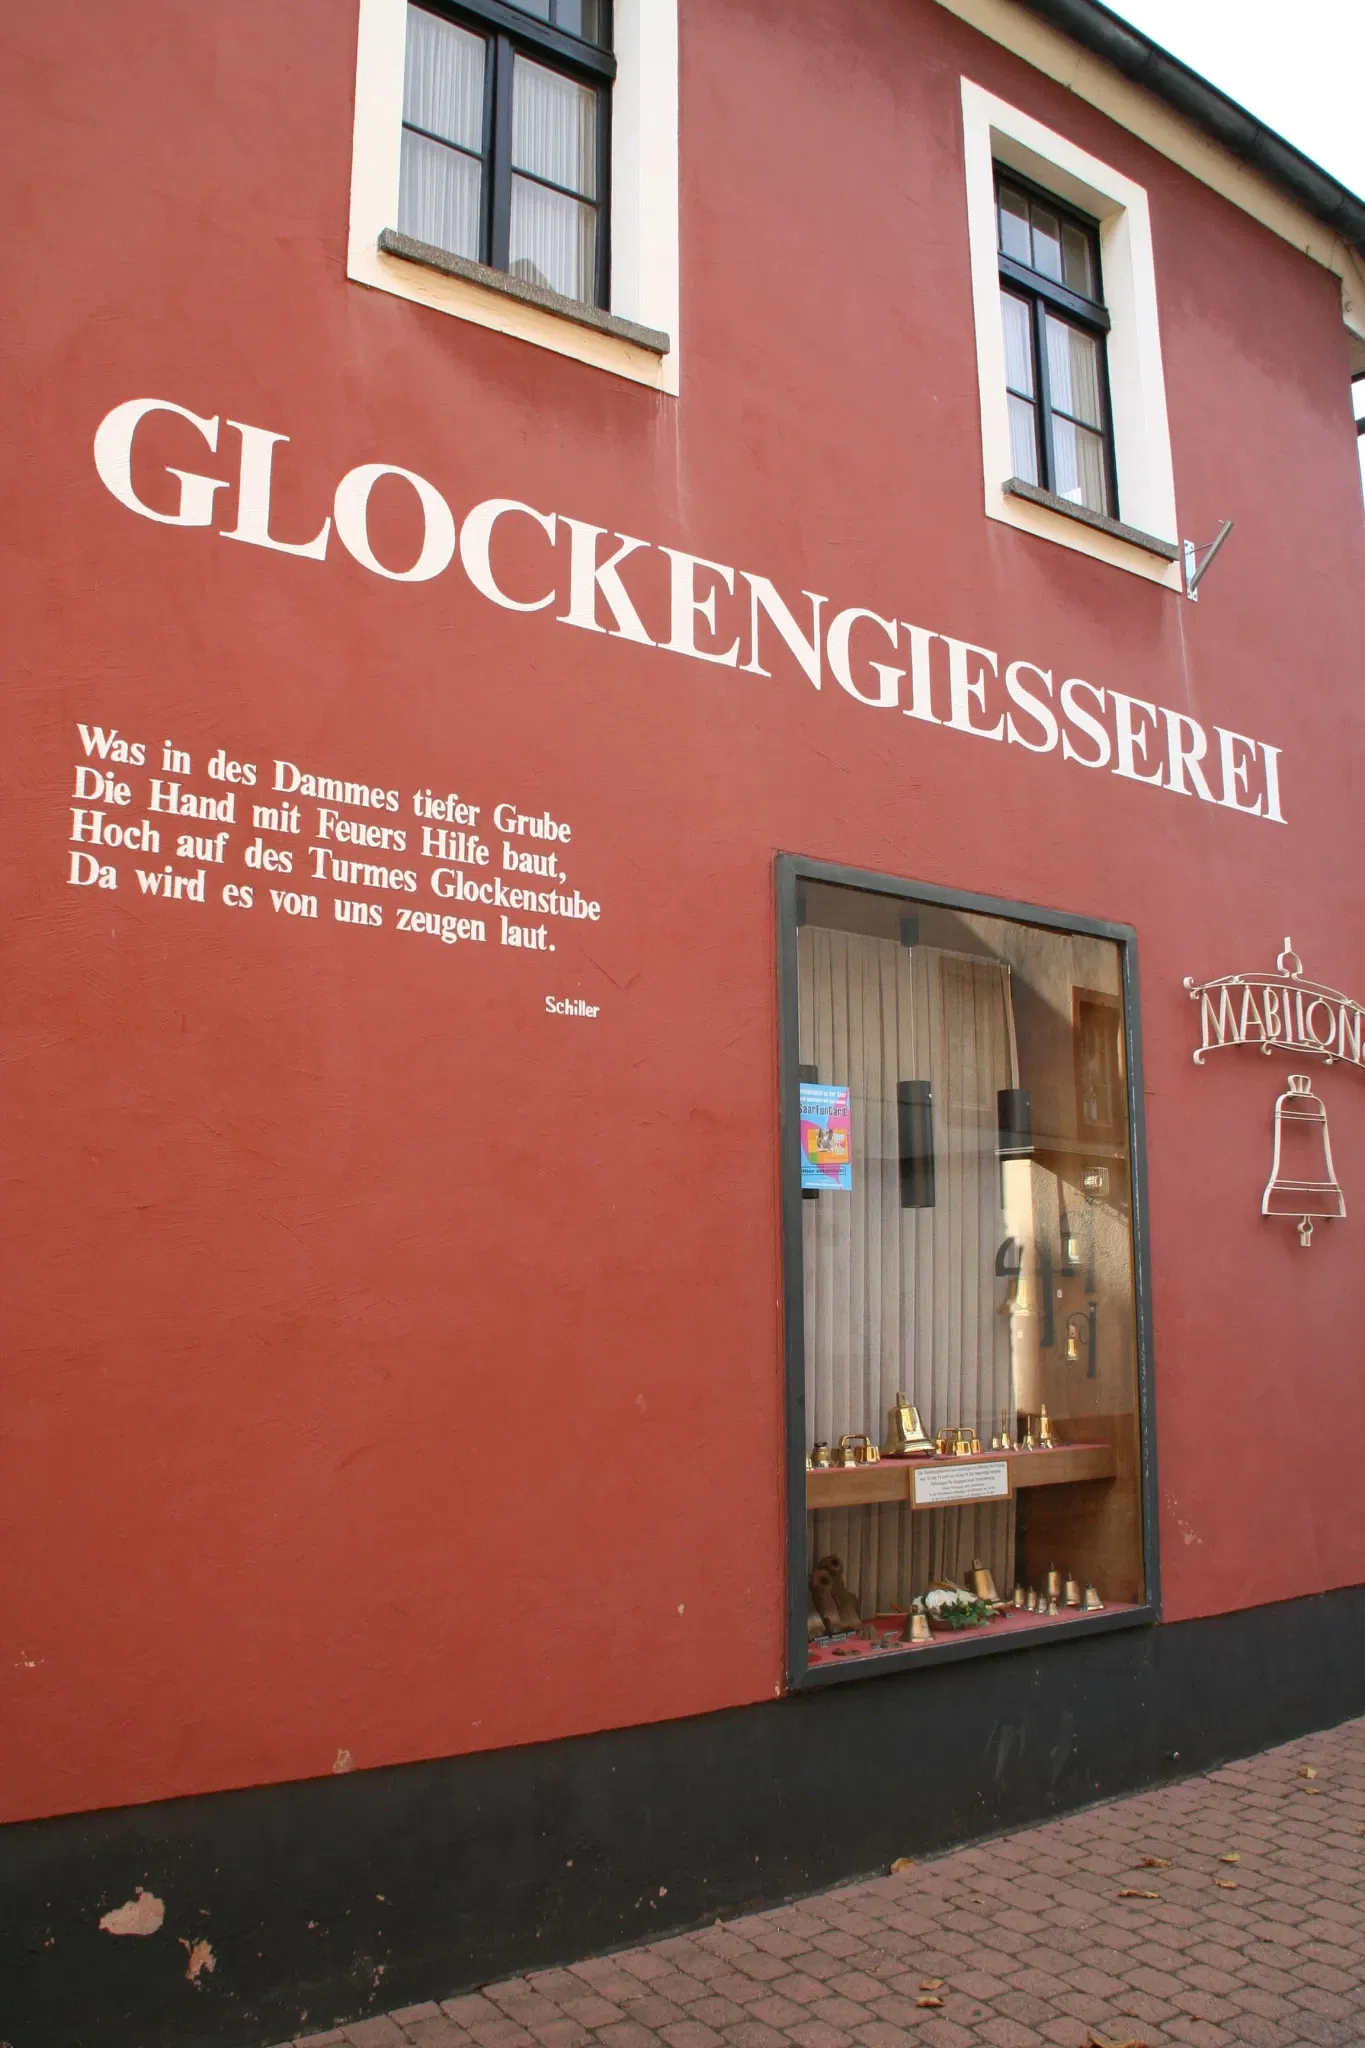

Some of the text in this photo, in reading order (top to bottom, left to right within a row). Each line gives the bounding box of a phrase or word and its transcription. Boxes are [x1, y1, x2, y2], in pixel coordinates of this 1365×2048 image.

[94, 398, 1289, 826] GLOCKENGIESSEREI
[72, 766, 567, 885] Die Hand mit Feuers Hilfe baut,
[77, 724, 571, 844] Was in des Dammes tiefer Grube
[67, 851, 556, 952] Da wird es von uns zeugen laut.
[69, 808, 601, 921] Hoch auf des Turmes Glockenstube
[546, 996, 601, 1019] Schiller
[1201, 985, 1361, 1064] MABILON
